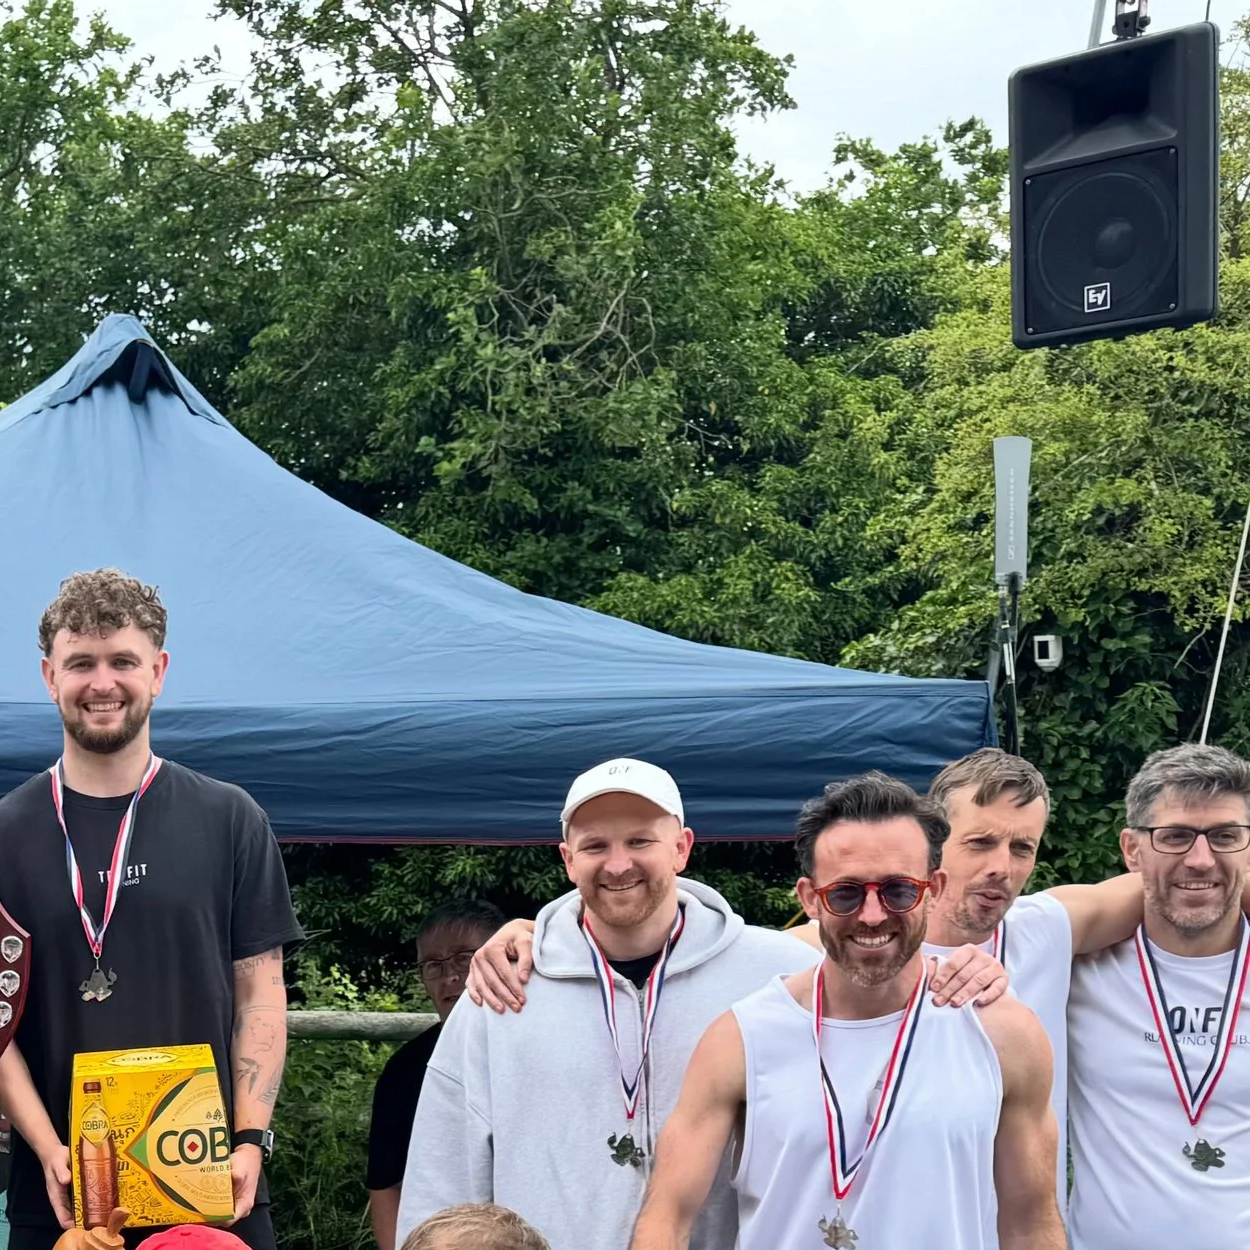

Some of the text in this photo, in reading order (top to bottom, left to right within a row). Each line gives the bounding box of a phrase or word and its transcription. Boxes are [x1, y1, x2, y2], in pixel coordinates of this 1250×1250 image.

[1144, 1032, 1207, 1046] RUING
[82, 1119, 108, 1131] COBRA
[156, 1126, 231, 1167] COB
